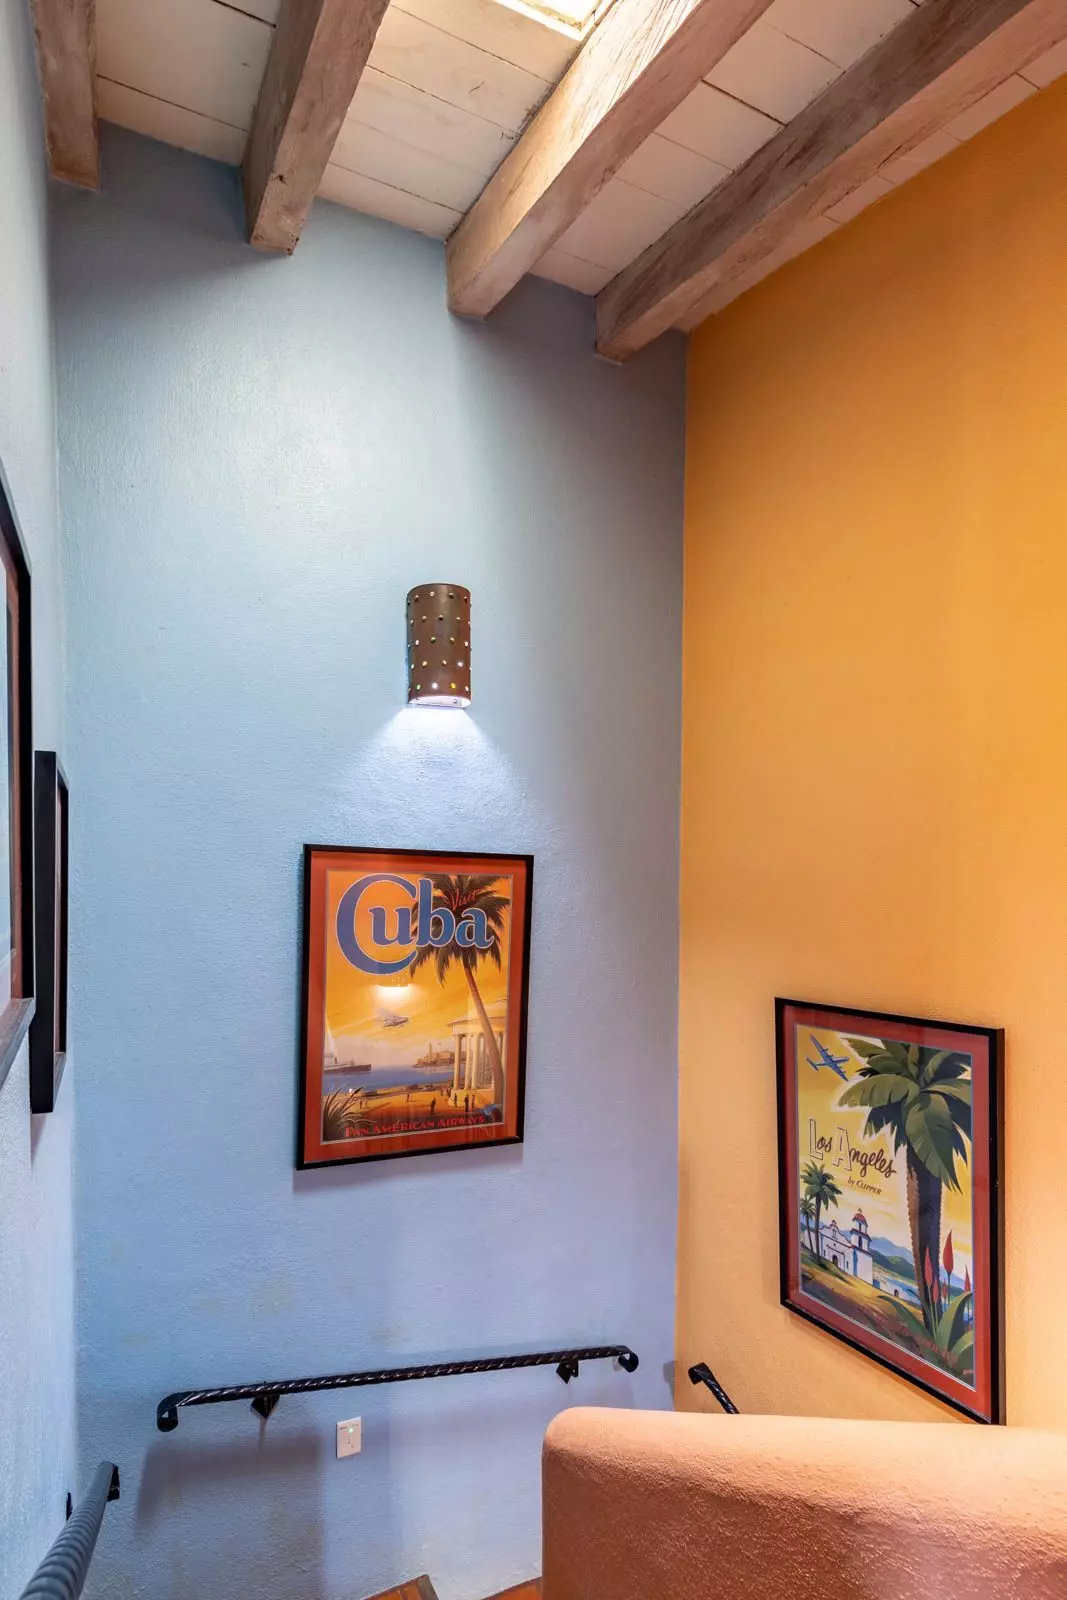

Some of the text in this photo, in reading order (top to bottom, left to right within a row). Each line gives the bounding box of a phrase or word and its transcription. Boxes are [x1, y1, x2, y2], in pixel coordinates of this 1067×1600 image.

[336, 873, 494, 976] Cuba
[373, 1121, 435, 1133] AMERICAN
[438, 1116, 485, 1128] AIRWAYS
[808, 1118, 897, 1178] Los Angeles
[847, 1176, 882, 1195] by CLIPPER
